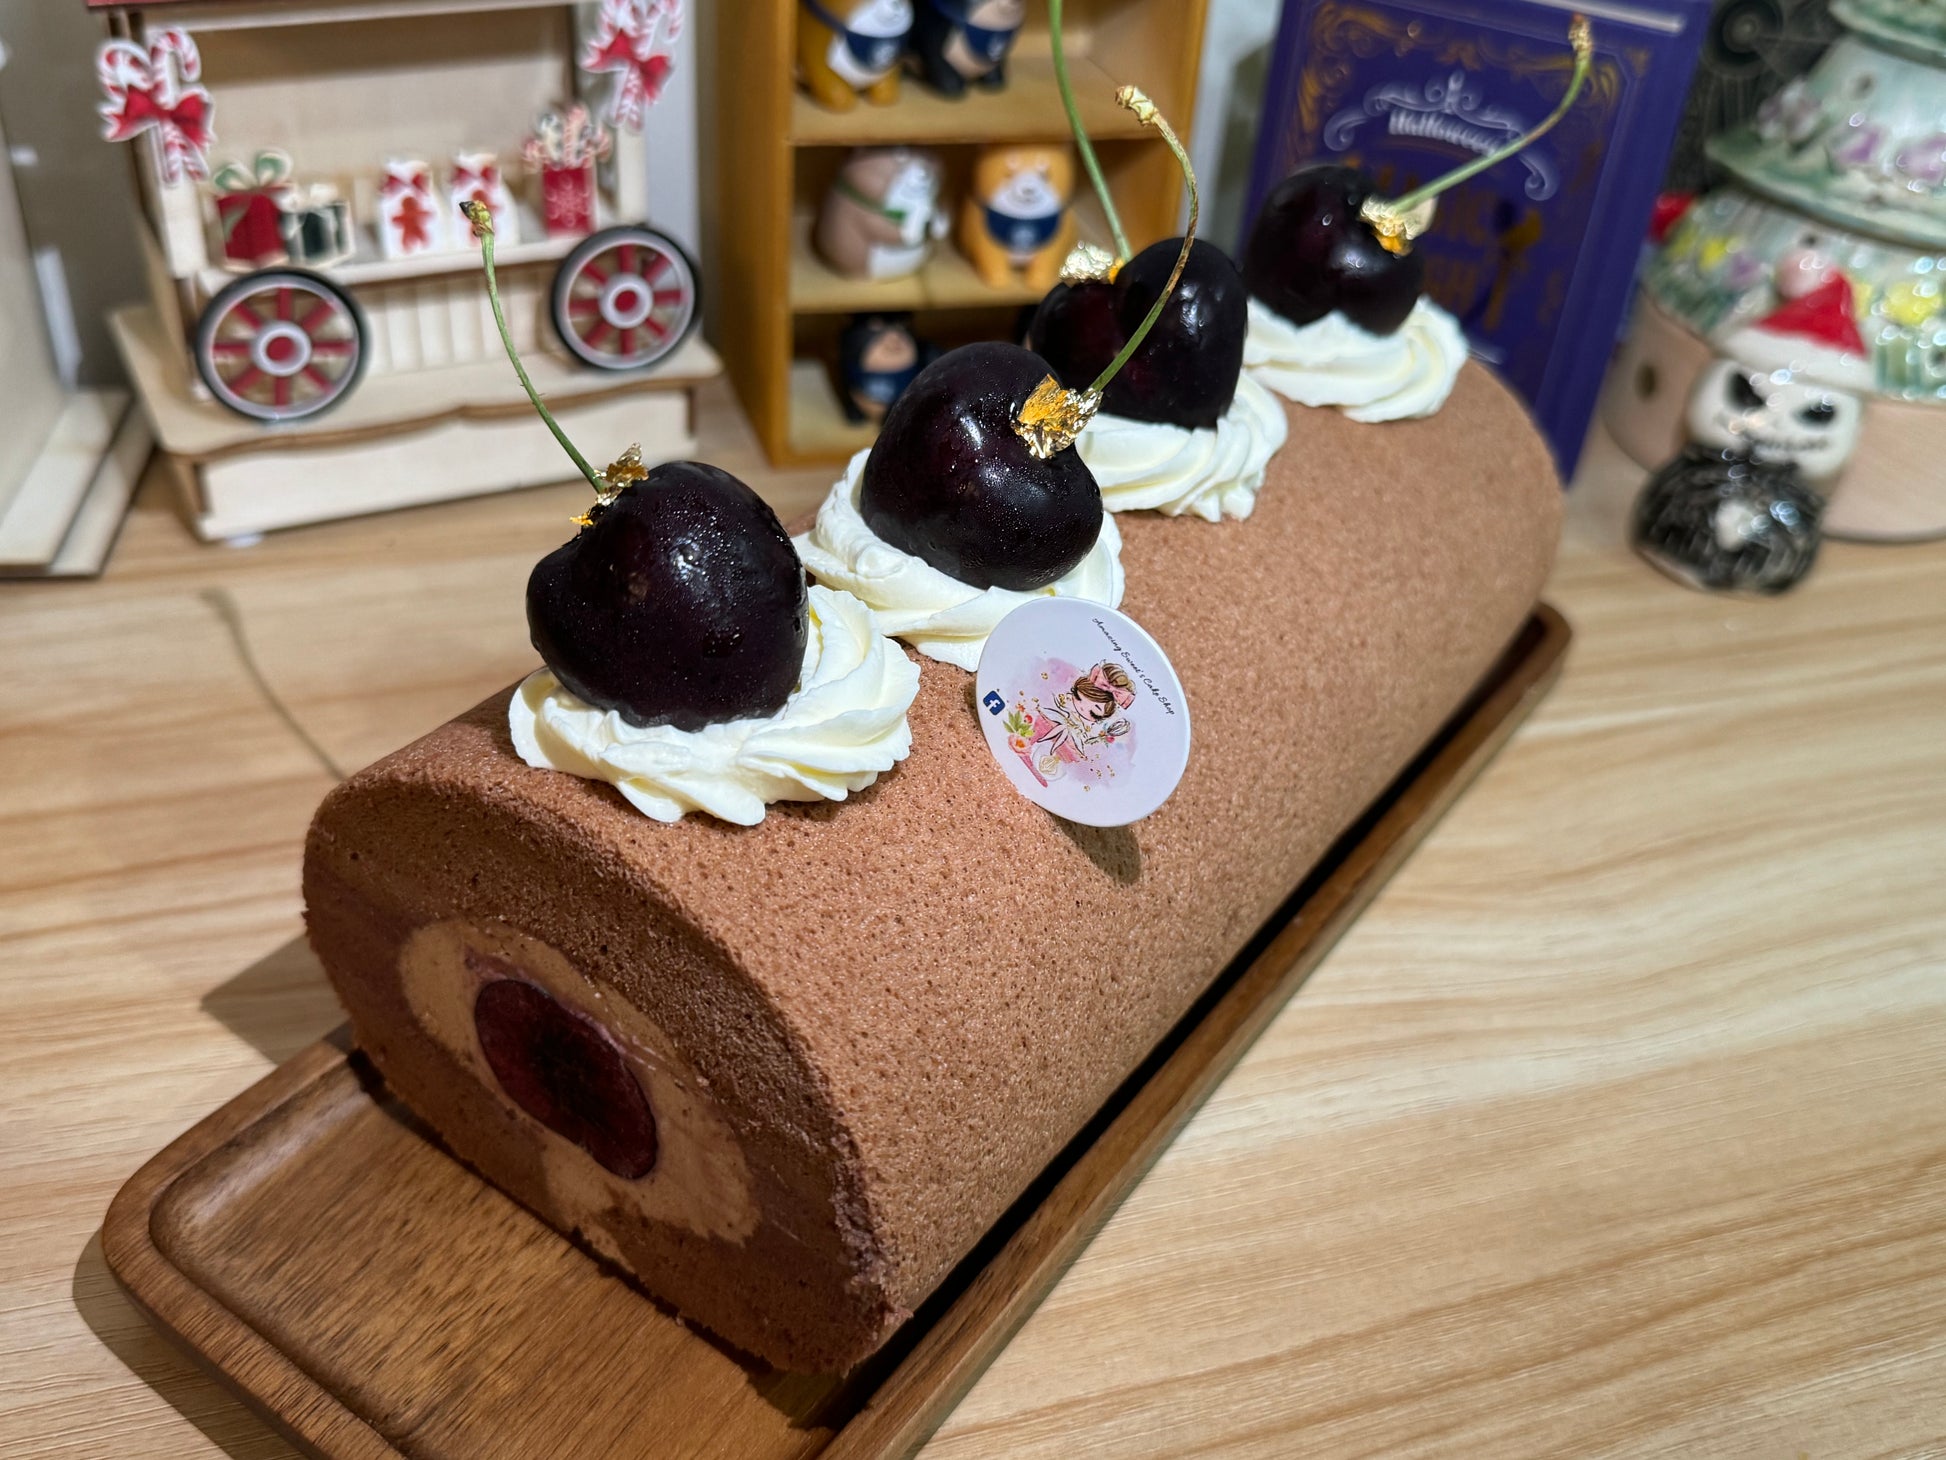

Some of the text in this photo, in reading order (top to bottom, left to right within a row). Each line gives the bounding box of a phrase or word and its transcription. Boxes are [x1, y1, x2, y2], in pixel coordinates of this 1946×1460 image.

[1092, 618, 1175, 715] Amazing Sweet's Cake Shop
